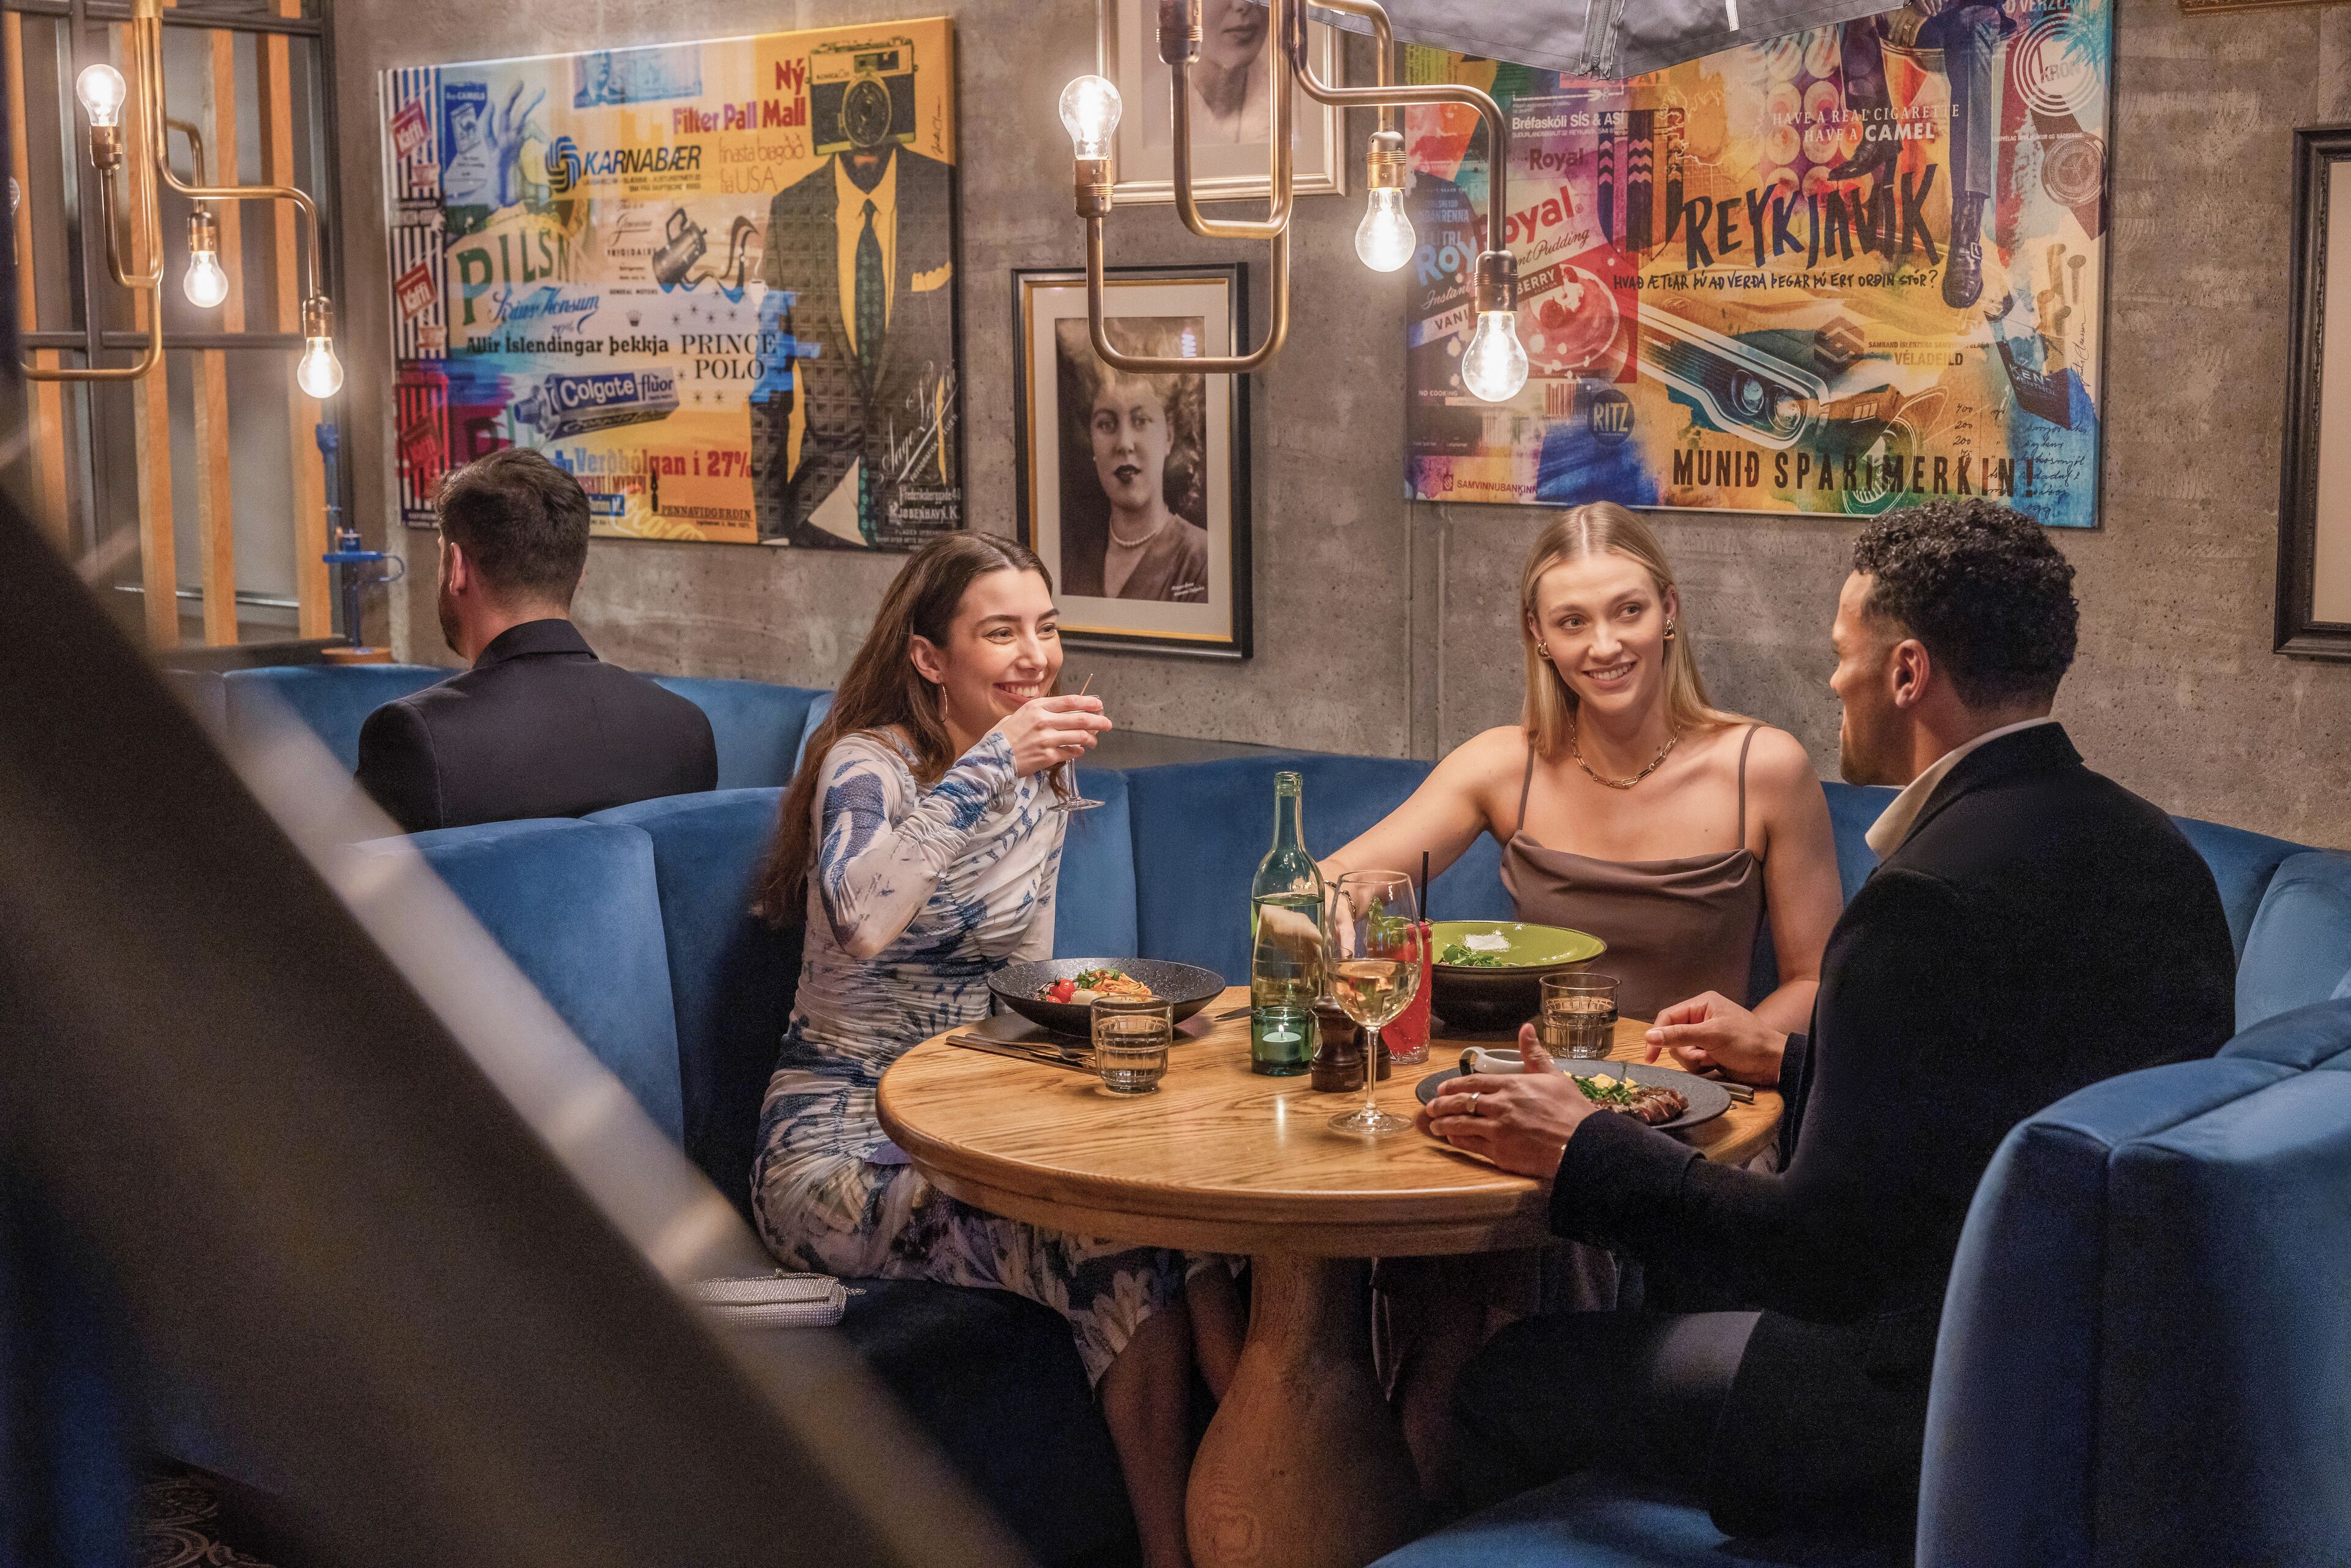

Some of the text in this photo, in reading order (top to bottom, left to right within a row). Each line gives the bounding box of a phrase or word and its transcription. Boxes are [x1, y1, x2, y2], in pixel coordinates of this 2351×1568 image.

[776, 58, 805, 95] Ný
[673, 97, 805, 134] Filter Pall Mall
[1512, 108, 1625, 130] Bréfaskóli SÍS & ASÍ
[1773, 104, 1959, 125] HAVE A REAL CIGARETTE
[1805, 122, 1935, 143] HAVE A CAMEL
[583, 145, 702, 176] KARNABÆR
[1530, 148, 1584, 171] Royal
[735, 165, 779, 194] USA
[1533, 229, 1590, 260] Pudding
[1414, 236, 1477, 287] ROY
[1517, 269, 1556, 294] BERRY
[1613, 274, 1644, 290] HVAÐ
[1648, 273, 1689, 290] ÆTLAR
[1693, 270, 1707, 290] ÞÚ
[1709, 276, 1725, 290] AÐ
[1728, 269, 1767, 291] VERÐA
[1771, 272, 1810, 289] ÞEGAR
[1813, 271, 1827, 288] ÞÚ
[1830, 272, 1854, 288] ERT
[1858, 274, 1895, 288] ORÐIN
[1435, 309, 1469, 330] VANI
[466, 331, 669, 356] Allir Íslendingar þekkja
[680, 334, 778, 354] PRINCE
[695, 359, 765, 380] POLO
[1894, 350, 1963, 366] VÉLADEILD
[560, 377, 635, 407] Colgate
[1593, 402, 1629, 432] RITZ
[1954, 421, 1973, 430] 200
[1952, 435, 1971, 446] 200
[707, 451, 753, 479] 27%
[1673, 449, 1760, 487] MUNIÐ
